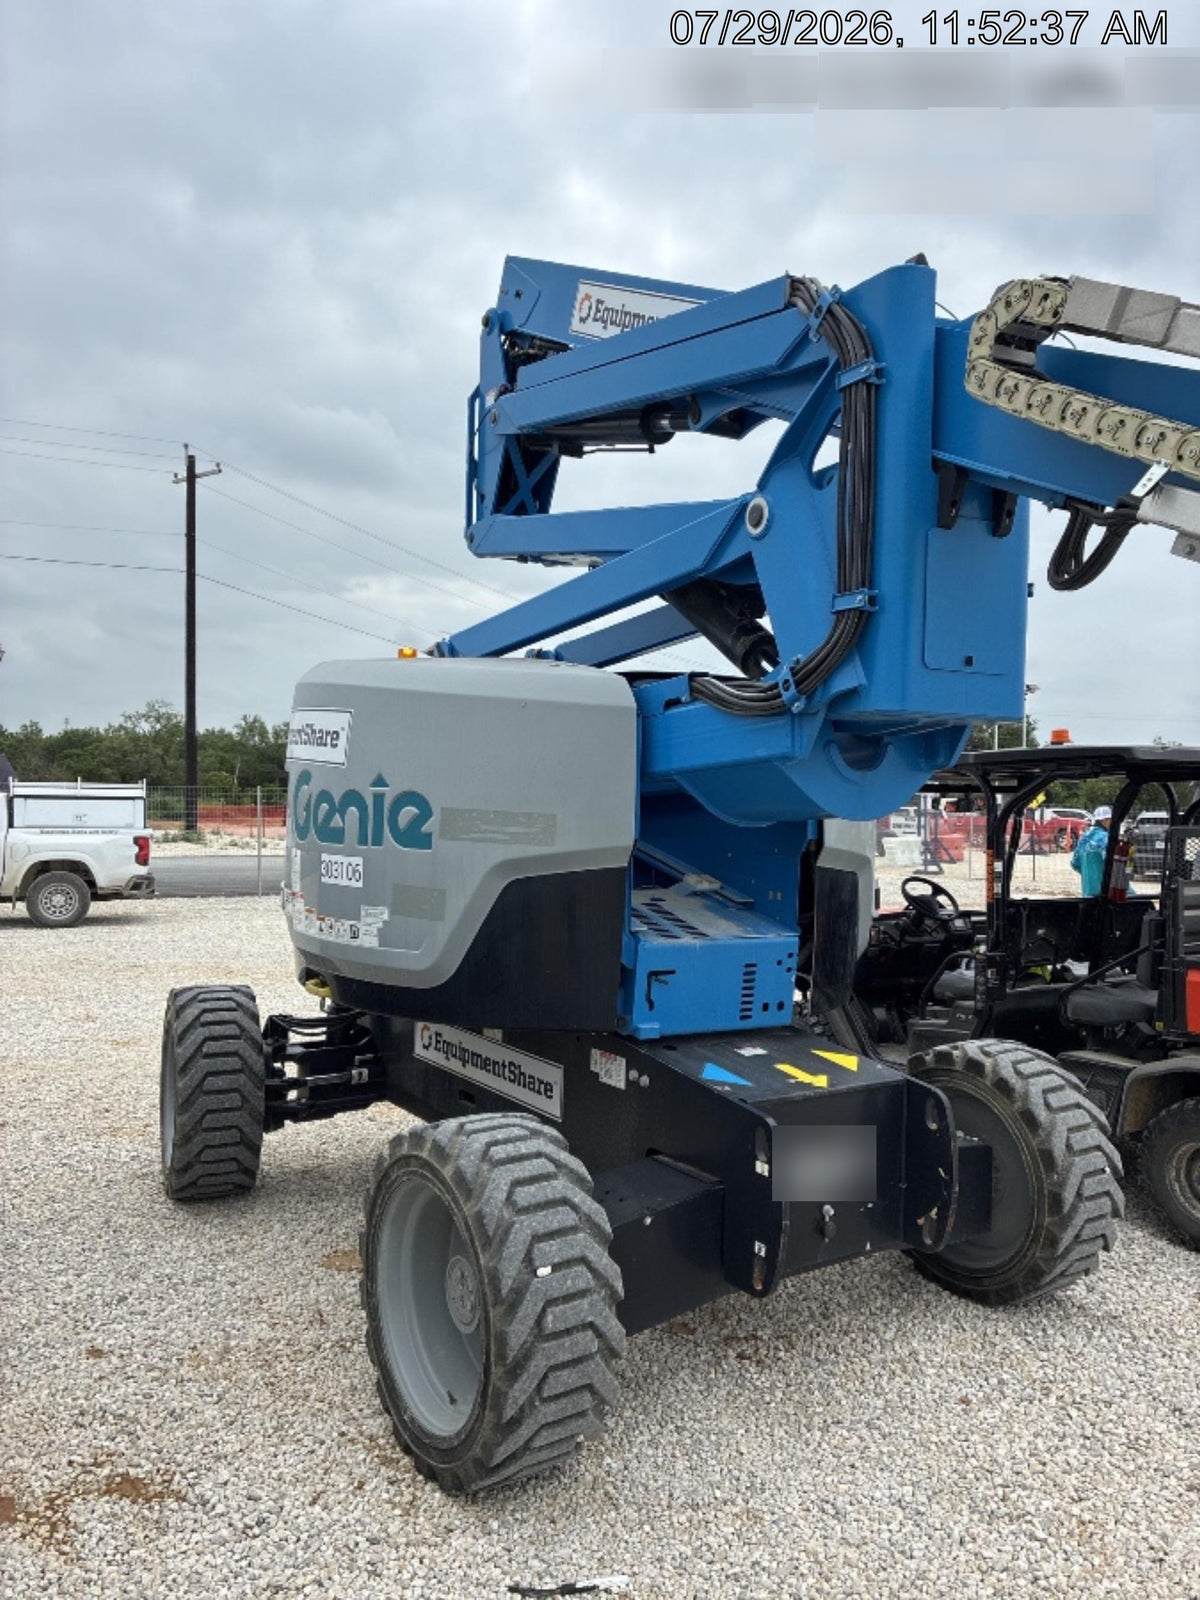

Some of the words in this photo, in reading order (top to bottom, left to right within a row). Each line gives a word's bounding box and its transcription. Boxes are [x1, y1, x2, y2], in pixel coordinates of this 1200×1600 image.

[294, 770, 434, 851] Genie
[320, 859, 362, 882] 303106
[433, 1031, 554, 1100] EquipmentShare
